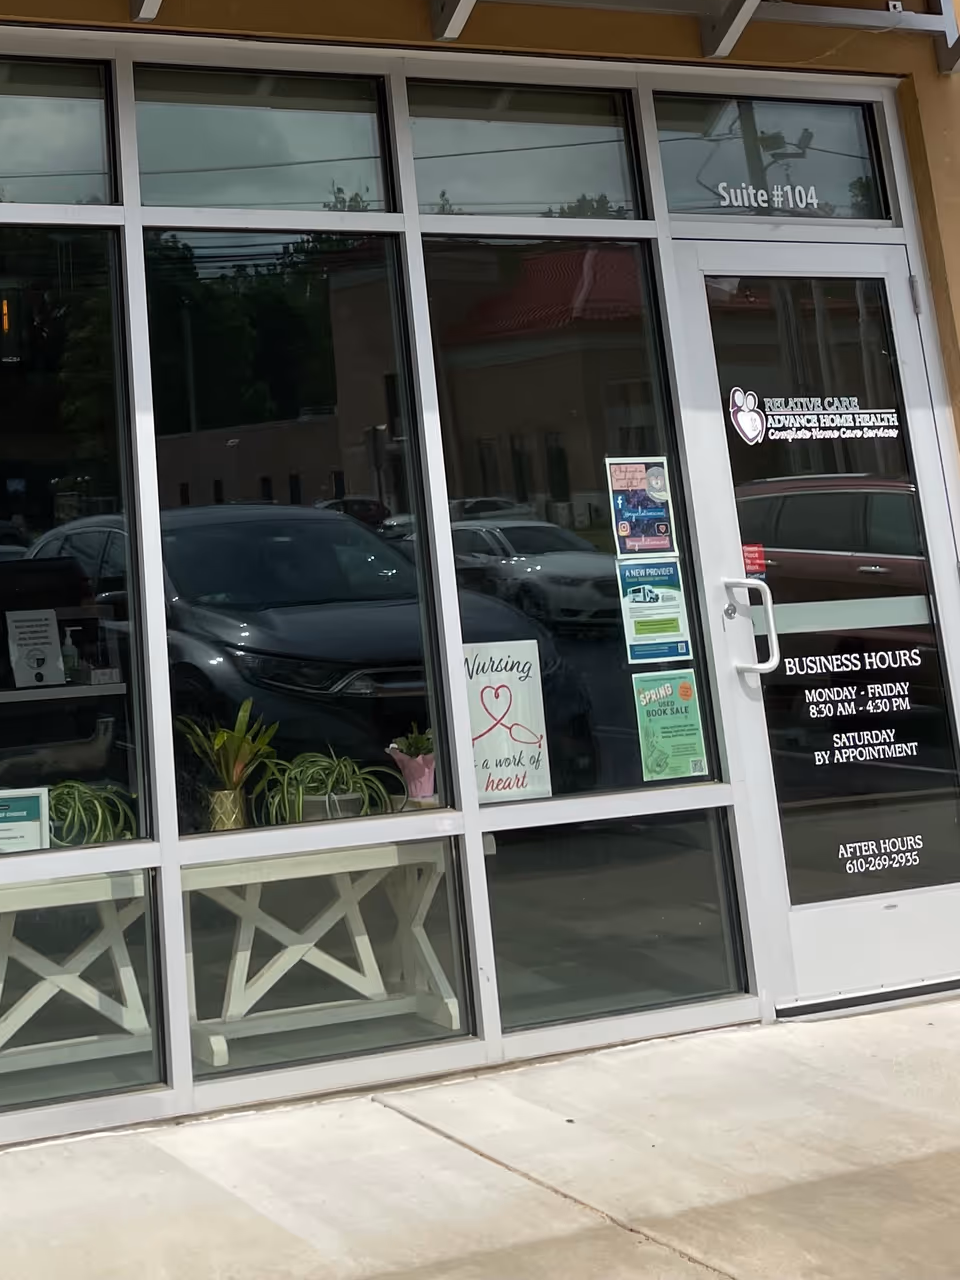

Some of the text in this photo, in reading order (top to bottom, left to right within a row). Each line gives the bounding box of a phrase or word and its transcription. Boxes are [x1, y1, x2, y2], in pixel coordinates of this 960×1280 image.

[718, 182, 819, 209] Suite #104
[763, 396, 860, 412] RELATIVE CARE
[767, 413, 899, 428] ADVANCE HOME HEALTH
[768, 426, 899, 442] Complete Home Care Services
[625, 567, 674, 578] A NEW PROVIDER
[464, 653, 533, 682] Nursing
[784, 648, 922, 676] BUSINESS HOURS
[639, 683, 673, 706] SPRING
[804, 686, 857, 703] MONDAY
[867, 681, 910, 698] FRIDAY
[646, 705, 689, 718] BOOK SALE
[658, 700, 675, 708] USED
[809, 704, 834, 718] 8:30
[836, 701, 857, 716] AM
[866, 699, 890, 713] 4:30
[892, 697, 911, 711] PM
[832, 728, 896, 748] SATURDAY
[481, 758, 491, 770] a
[495, 750, 525, 768] work
[529, 751, 542, 770] of
[814, 741, 919, 766] BY APPOINTMENT
[485, 770, 529, 793] heart
[838, 835, 923, 858] AFTER HOURS
[845, 851, 920, 873] 610-269-2935
